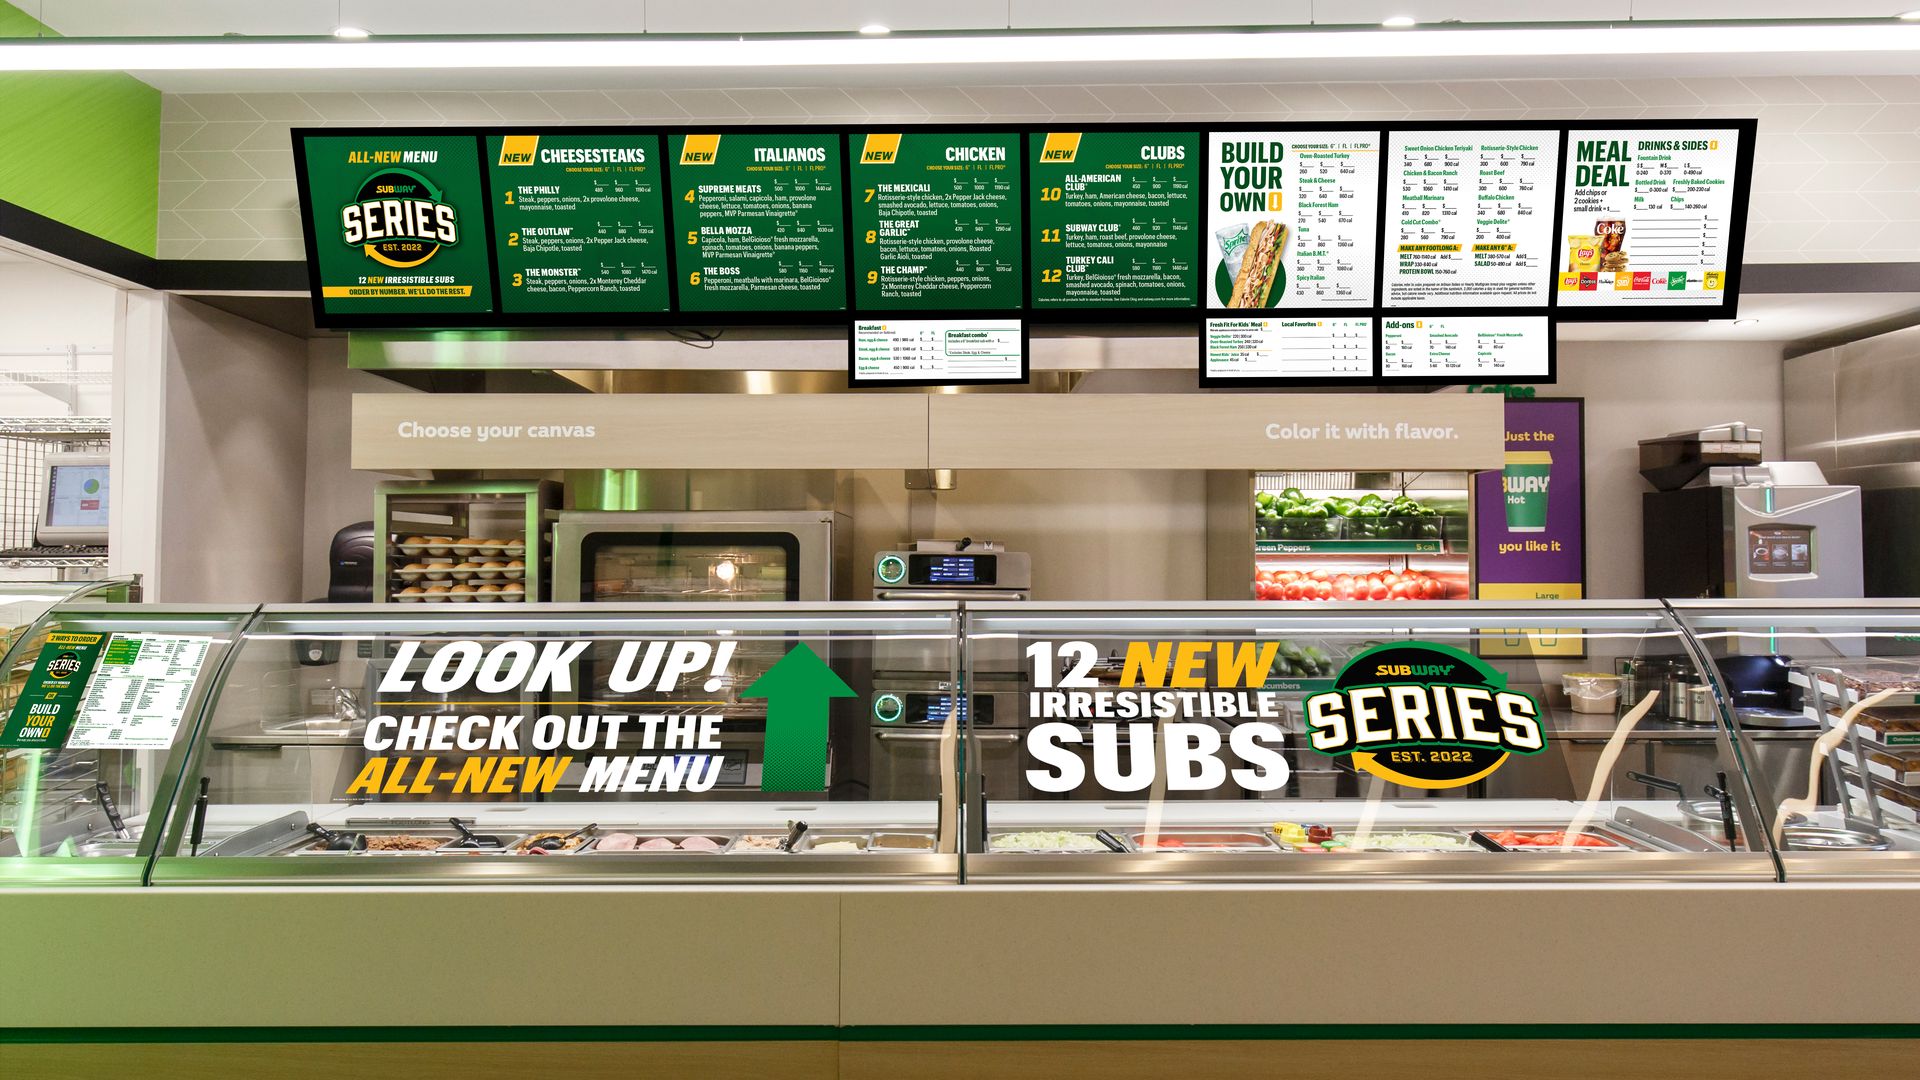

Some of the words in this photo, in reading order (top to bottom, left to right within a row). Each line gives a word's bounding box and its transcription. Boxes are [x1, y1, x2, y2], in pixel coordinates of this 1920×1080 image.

[1576, 140, 1631, 162] MEAL
[1638, 141, 1672, 150] DRINKS
[1673, 141, 1680, 150] &
[1682, 140, 1708, 150] SIDES
[348, 151, 401, 163] ALL-NEW
[403, 151, 438, 163] MENU
[504, 153, 531, 162] NEW
[541, 149, 645, 163] CHEESESTEAKS
[685, 153, 712, 161] NEW
[754, 148, 826, 162] ITALIANOS
[865, 152, 893, 160] NEW
[946, 147, 1005, 161] CHICKEN
[1045, 151, 1073, 159] NEW
[1141, 146, 1185, 160] CLUBS
[1221, 142, 1283, 163] BUILD
[1220, 167, 1282, 189] YOUR
[1575, 165, 1629, 187] DEAL
[533, 186, 560, 194] PHILLY
[684, 190, 694, 203] 4
[865, 189, 875, 202] 7
[1041, 188, 1061, 201] 10
[505, 192, 514, 204] 1
[1220, 192, 1265, 212] OWN
[343, 200, 456, 243] SERIES
[1041, 229, 1060, 242] 11
[1596, 223, 1624, 235] Coke
[508, 233, 518, 246] 2
[688, 232, 698, 244] 5
[866, 230, 876, 243] 8
[1225, 233, 1248, 249] Sprite
[512, 273, 522, 286] 3
[690, 272, 700, 285] 6
[867, 271, 878, 284] 9
[1042, 269, 1062, 282] 12
[398, 421, 472, 438] Choose
[477, 425, 522, 442] your
[528, 425, 595, 438] canvas
[1265, 423, 1320, 440] Color
[1325, 423, 1340, 440] it
[1345, 423, 1390, 440] with
[1395, 423, 1459, 440] flavor.
[1504, 431, 1530, 441] Just
[1533, 431, 1554, 441] the
[1507, 496, 1525, 504] Hot
[1278, 544, 1310, 552] Peppers
[1499, 542, 1522, 554] you
[1526, 540, 1548, 551] like
[1551, 540, 1561, 551] it
[46, 659, 81, 672] SERIES
[377, 641, 593, 693] LOOK
[608, 641, 738, 693] UP!
[1025, 640, 1099, 689] 12
[1118, 641, 1280, 688] NEW
[1374, 663, 1455, 678] SUBWAY
[30, 704, 60, 714] BUILD
[1029, 691, 1279, 718] IRRESISTIBLE
[26, 715, 56, 727] YOUR
[1306, 685, 1547, 752] SERIES
[19, 727, 42, 738] OWN
[363, 714, 523, 750] CHECK
[532, 714, 636, 750] OUT
[638, 715, 724, 749] THE
[1025, 722, 1290, 793] SUBS
[1390, 750, 1426, 763] EST.
[1430, 750, 1473, 763] 2022
[345, 755, 573, 794] ALL-NEW
[578, 755, 725, 793] MENU
